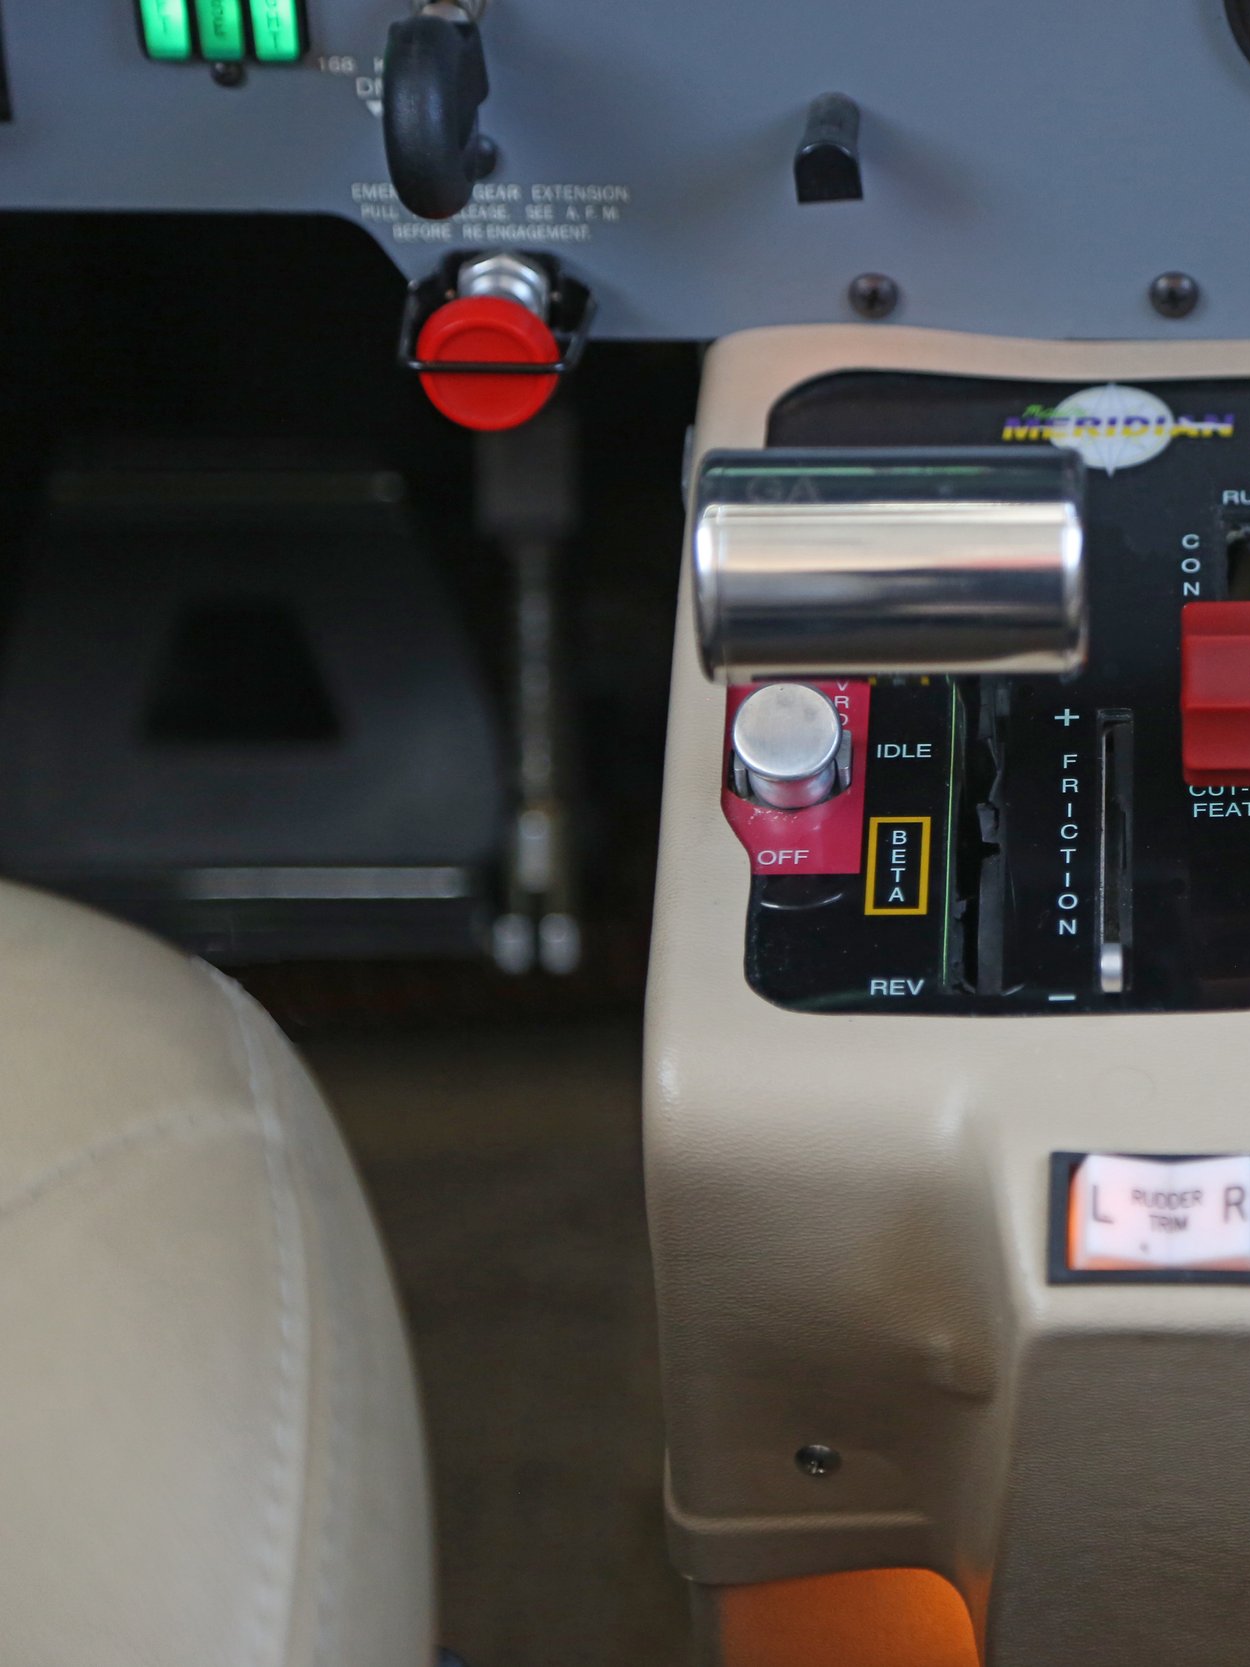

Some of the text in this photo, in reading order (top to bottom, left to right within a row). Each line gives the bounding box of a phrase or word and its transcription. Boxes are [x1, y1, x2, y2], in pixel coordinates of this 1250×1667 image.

[472, 184, 630, 203] GEAR EXTENSION
[361, 203, 399, 221] PULL
[525, 204, 554, 220] SEE
[393, 222, 451, 242] BEFORE
[1002, 413, 1235, 441] MERIDIAN
[876, 743, 932, 759] IDLE
[1057, 754, 1079, 936] FRICTION
[757, 850, 809, 866] OFF
[888, 830, 907, 902] BETA
[870, 979, 925, 996] REV
[1092, 1184, 1247, 1224] L RUDDER R
[1149, 1214, 1188, 1233] TRIM
